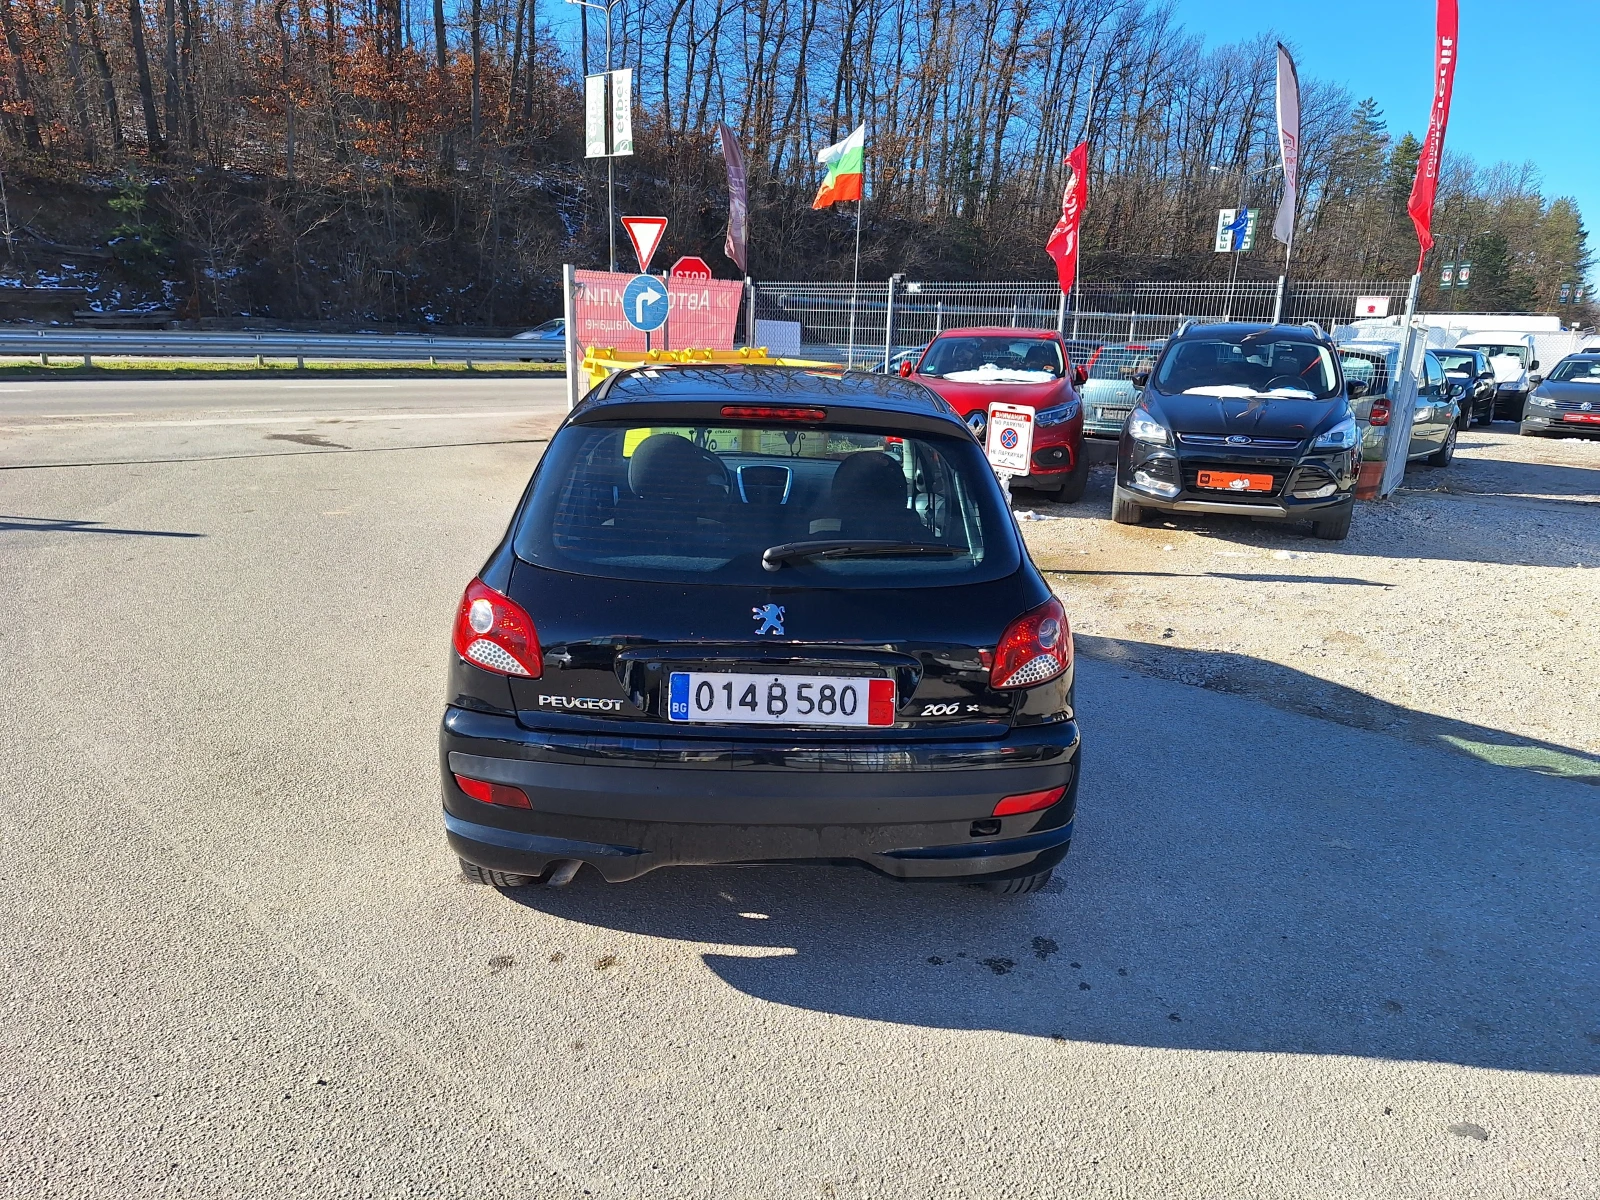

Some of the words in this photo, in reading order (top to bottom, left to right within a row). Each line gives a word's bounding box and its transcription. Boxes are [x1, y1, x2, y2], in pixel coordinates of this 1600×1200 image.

[616, 76, 624, 134] efbet
[1220, 212, 1232, 249] EFBET
[1242, 211, 1255, 250] EFBET
[676, 271, 707, 280] STOP
[538, 694, 624, 711] PEUGEOT
[672, 702, 687, 713] BG
[921, 702, 960, 716] 206
